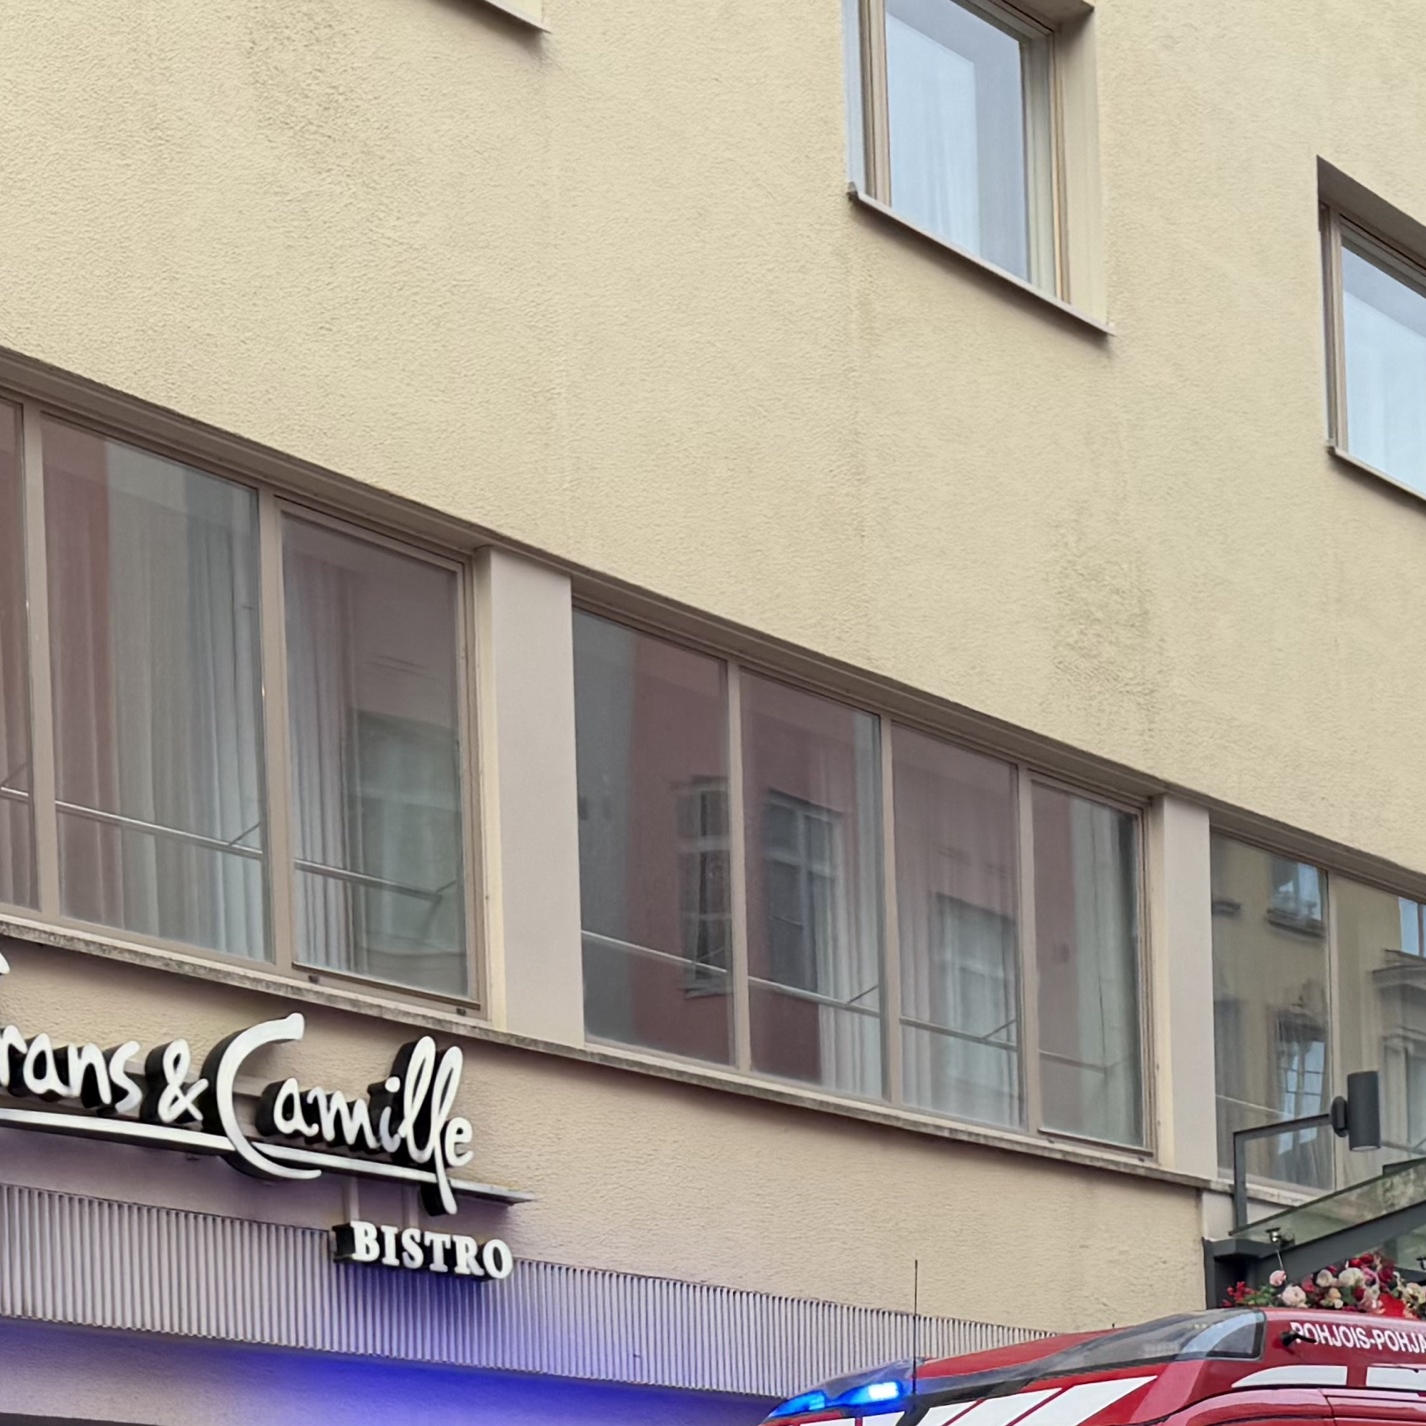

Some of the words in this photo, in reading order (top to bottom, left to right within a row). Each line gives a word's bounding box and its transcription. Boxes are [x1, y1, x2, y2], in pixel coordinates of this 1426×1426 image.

[159, 1038, 209, 1123] &
[217, 1013, 474, 1214] Camille
[350, 1220, 513, 1280] BISTRO
